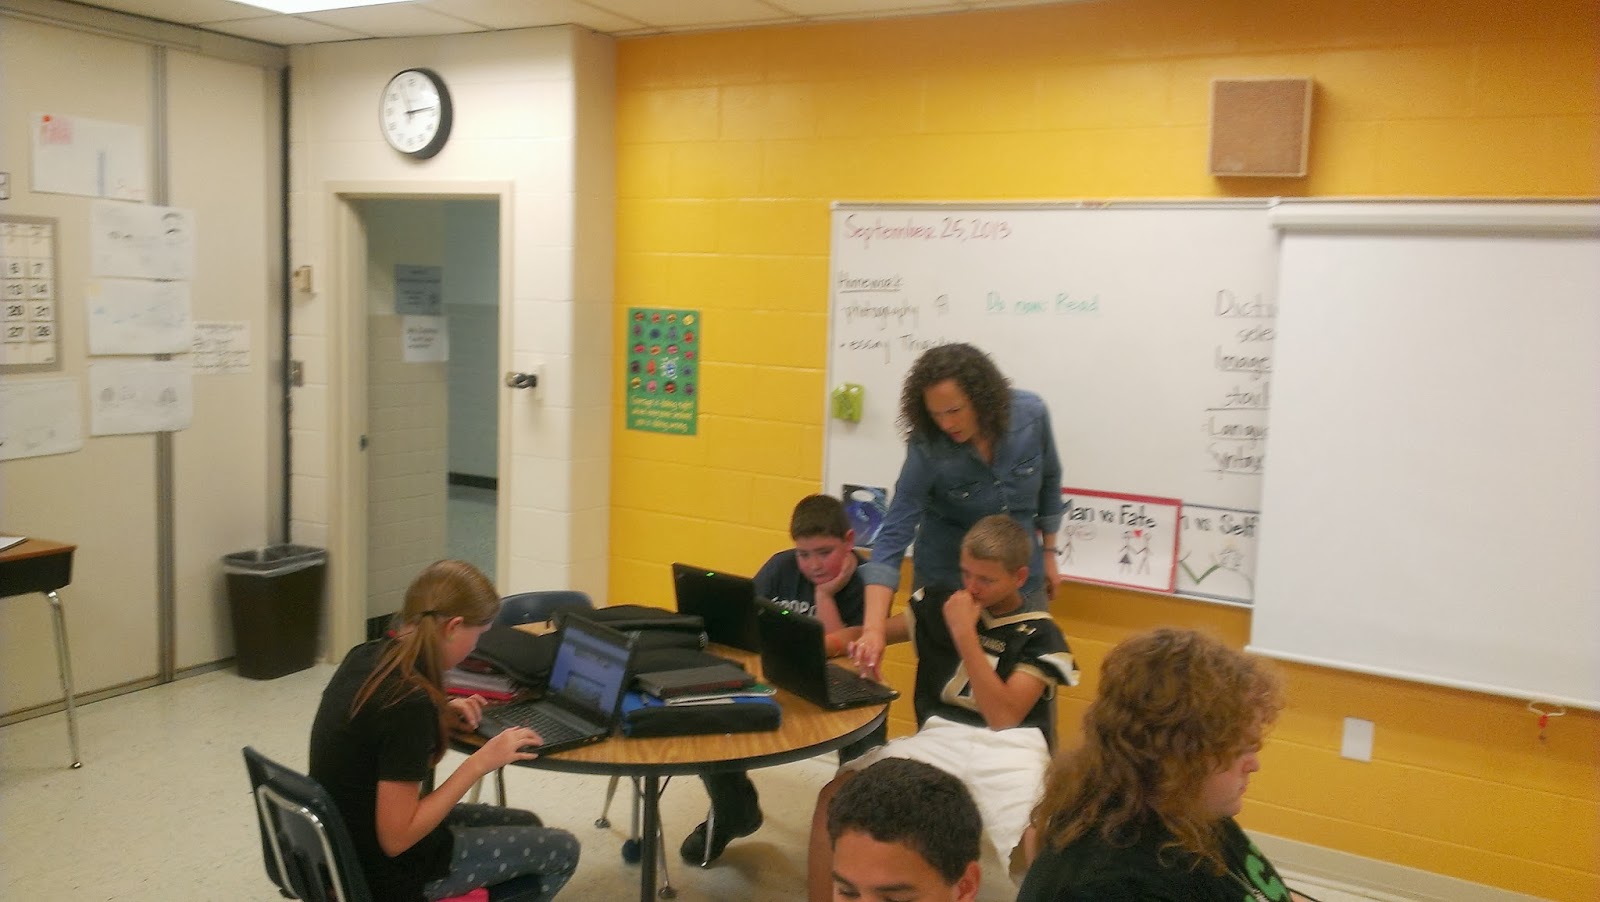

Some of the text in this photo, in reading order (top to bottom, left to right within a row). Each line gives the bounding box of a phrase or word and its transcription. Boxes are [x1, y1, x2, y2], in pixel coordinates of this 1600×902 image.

[843, 213, 938, 249] September
[1120, 504, 1157, 528] Fate
[1219, 514, 1260, 538] Self
